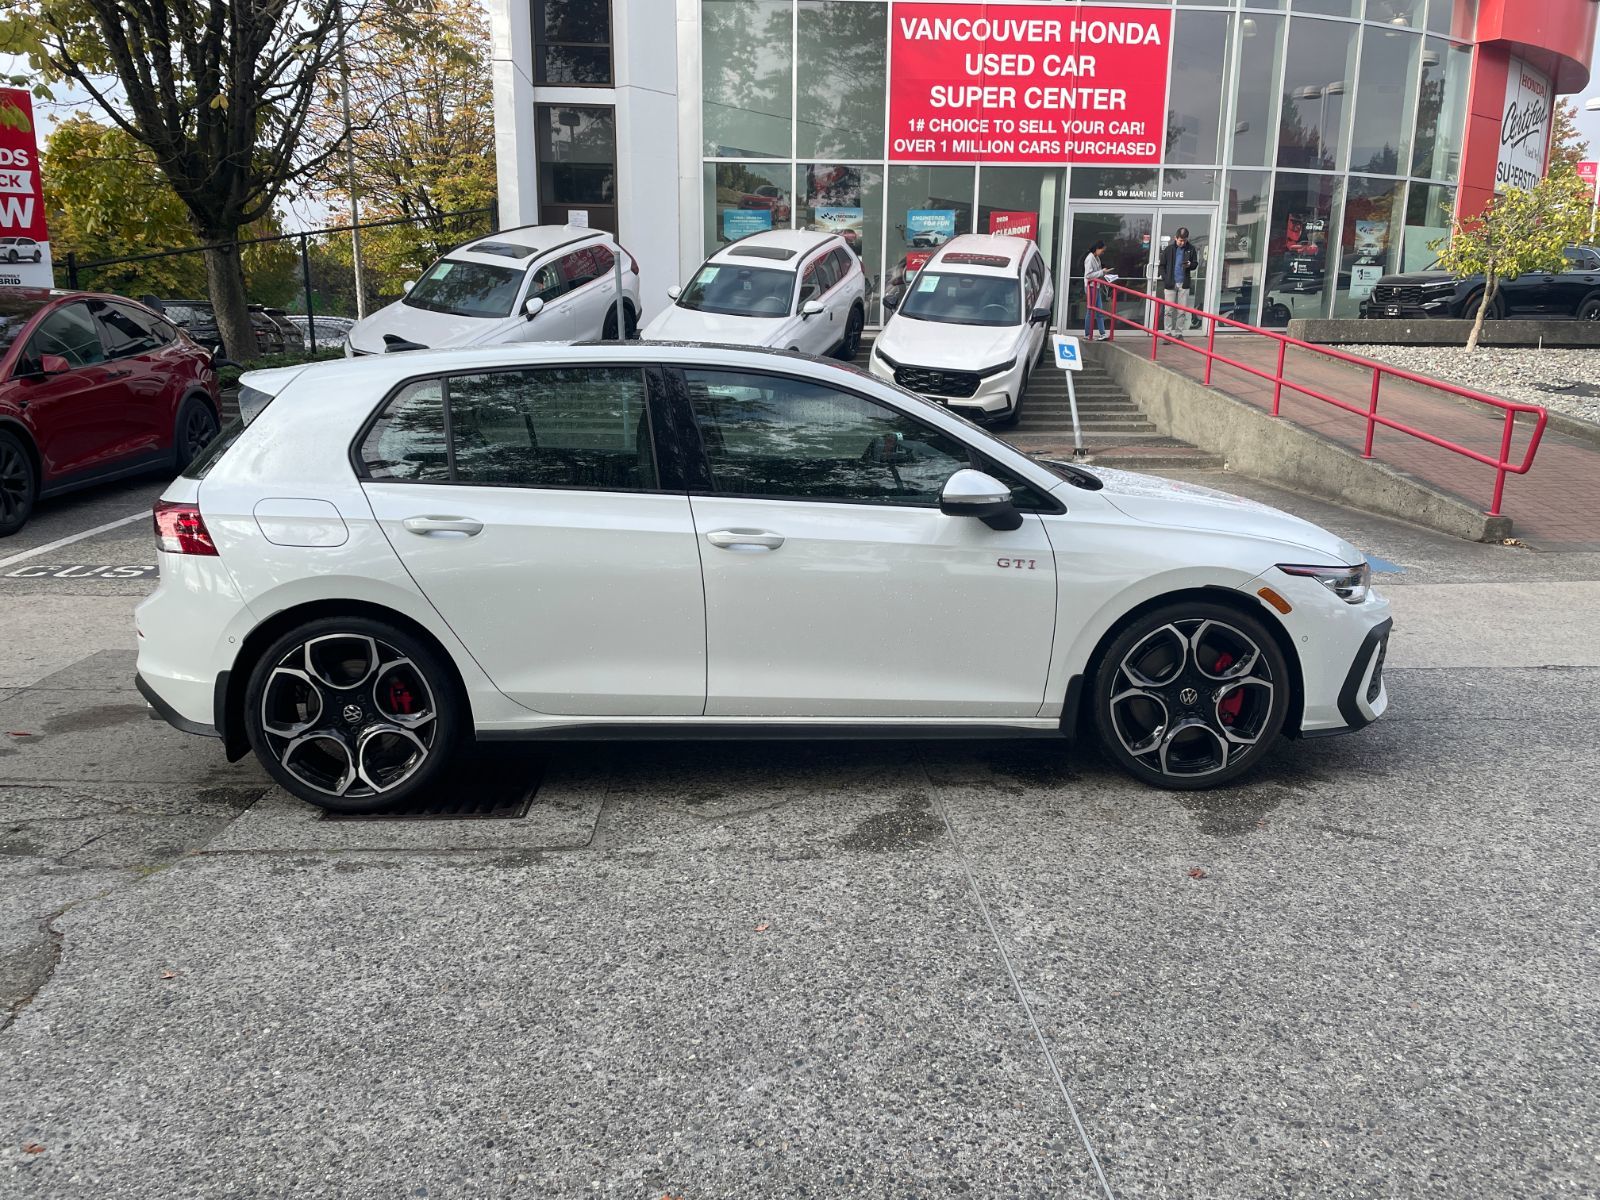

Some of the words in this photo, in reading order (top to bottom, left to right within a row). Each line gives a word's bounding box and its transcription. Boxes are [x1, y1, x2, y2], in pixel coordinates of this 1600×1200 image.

[900, 17, 1061, 42] VANCOUVER
[1070, 20, 1161, 45] HONDA
[964, 53, 1035, 76] USED
[1042, 54, 1096, 77] CAR
[1521, 73, 1546, 97] HONDA
[929, 85, 1016, 109] SUPER
[1024, 86, 1127, 110] CENTER
[908, 118, 925, 132] 1#
[929, 118, 989, 133] CHOICE
[993, 119, 1015, 133] TO
[1018, 119, 1057, 134] SELL
[1061, 120, 1104, 135] YOUR
[1108, 121, 1145, 136] CAR!
[1501, 100, 1547, 147] Certified
[894, 138, 936, 152] OVER
[940, 139, 947, 153] 1
[952, 139, 1014, 154] MILLION
[1018, 140, 1061, 154] CARS
[1064, 140, 1157, 156] PURCHASED
[1098, 189, 1113, 197] 850
[1129, 190, 1157, 198] MARINE
[995, 224, 1031, 236] CLEAROUT
[4, 565, 160, 578] CUS
[997, 557, 1036, 570] GTI
